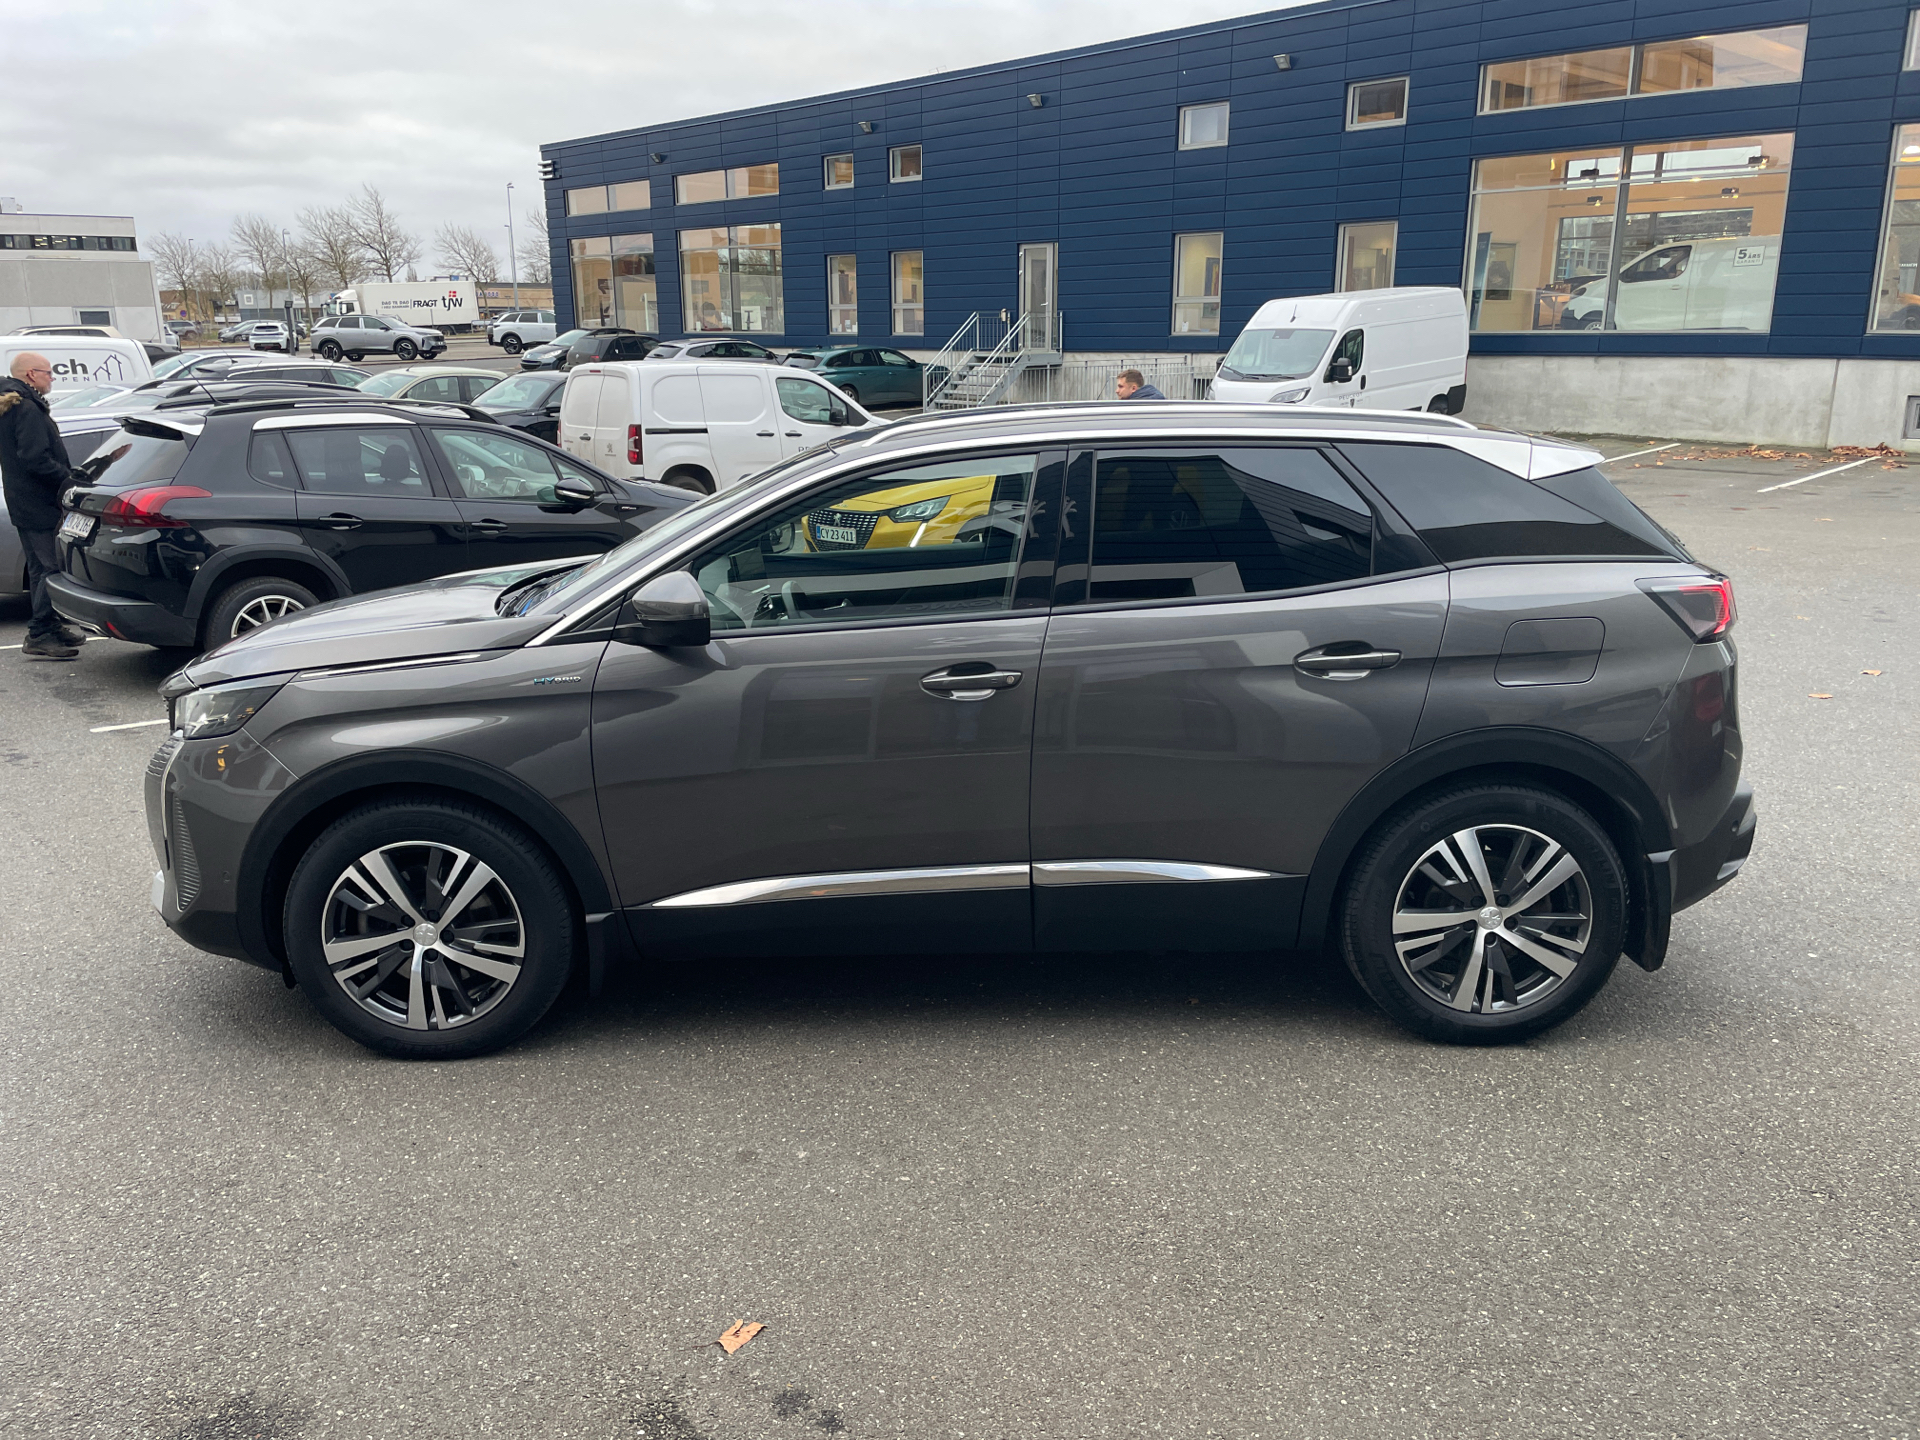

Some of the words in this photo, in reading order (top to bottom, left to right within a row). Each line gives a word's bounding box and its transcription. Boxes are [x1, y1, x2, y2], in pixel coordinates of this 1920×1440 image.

[1738, 249, 1748, 259] 5
[442, 296, 463, 311] tjw
[820, 529, 830, 539] CY
[830, 530, 840, 540] 23
[841, 531, 854, 542] 411
[533, 676, 581, 686] HYBRID
